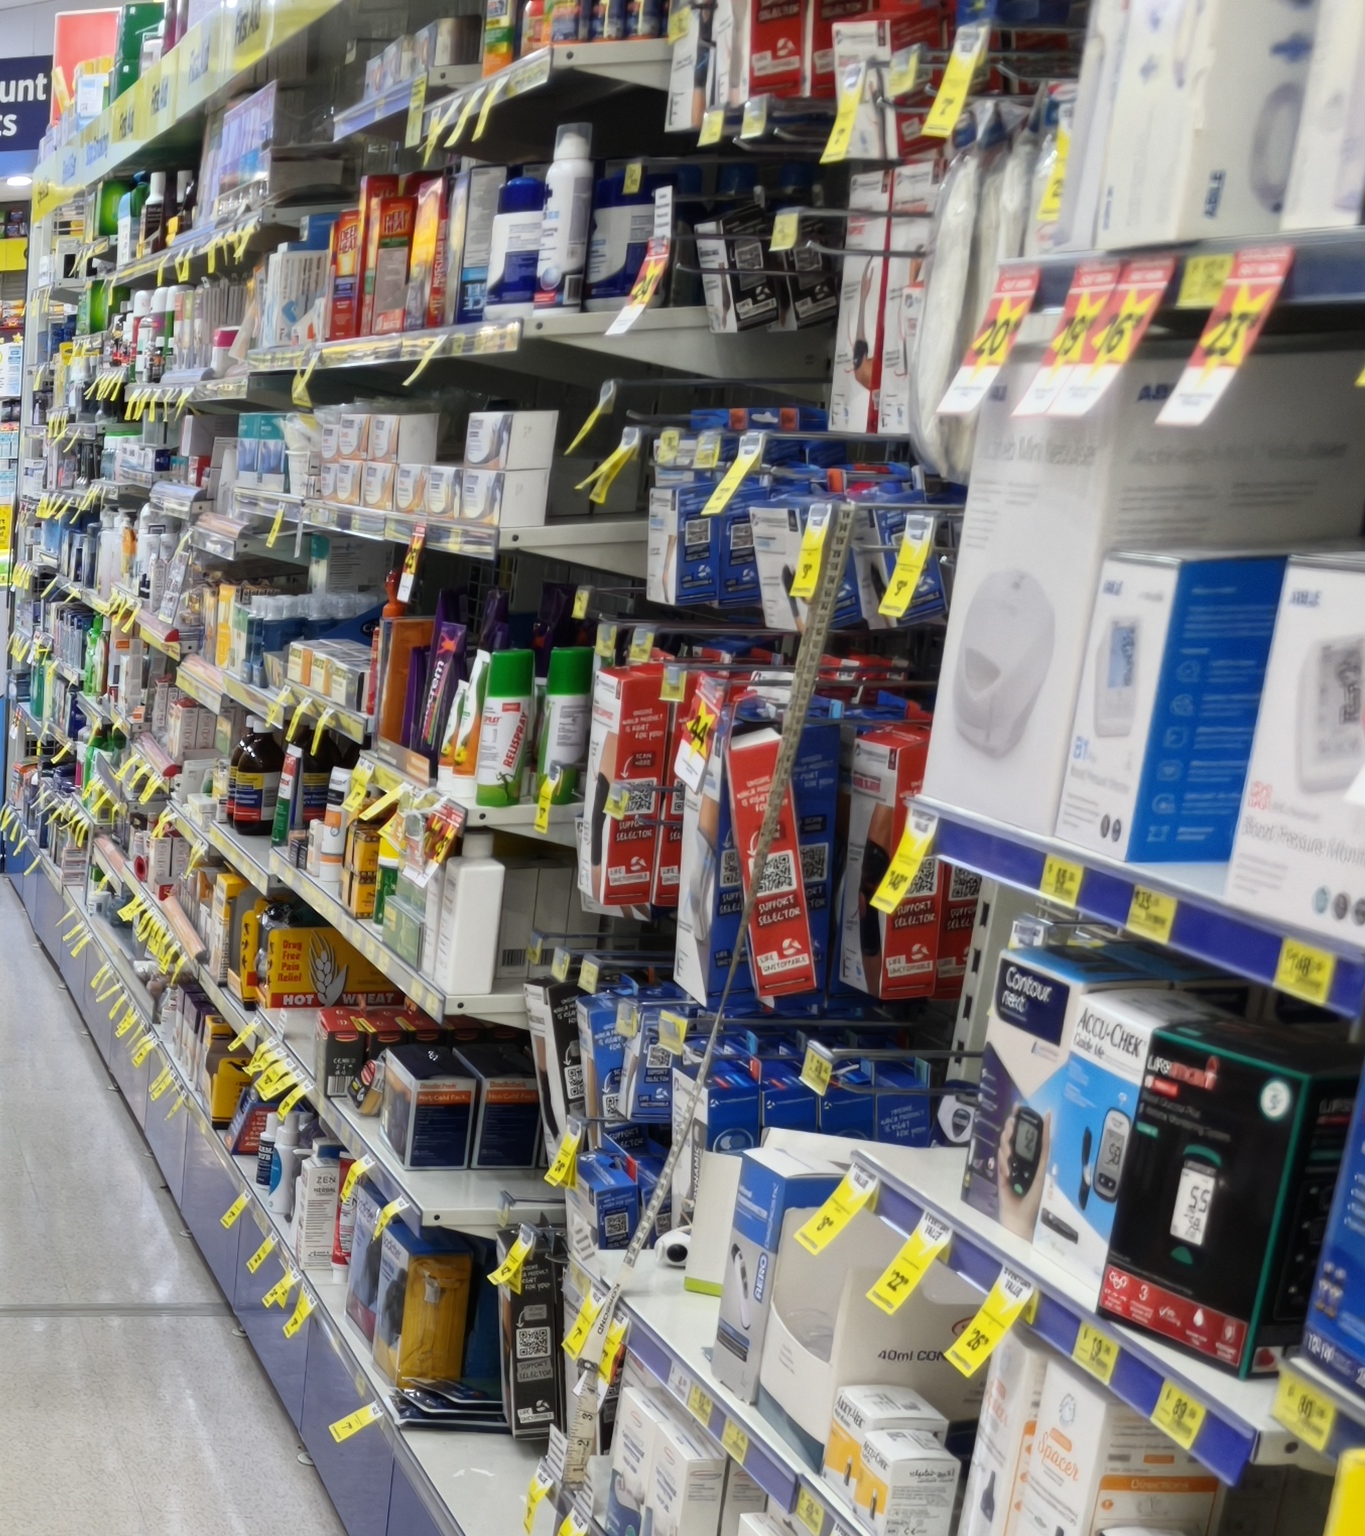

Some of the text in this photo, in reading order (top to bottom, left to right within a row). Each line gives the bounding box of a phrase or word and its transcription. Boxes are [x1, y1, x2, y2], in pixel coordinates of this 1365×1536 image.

[503, 712, 527, 768] RELISPRAY
[1005, 966, 1053, 1002] Contour
[1077, 1007, 1145, 1058] ACCU-CHEK
[877, 1350, 913, 1362] 40ml
[1039, 1432, 1079, 1482] Spacer
